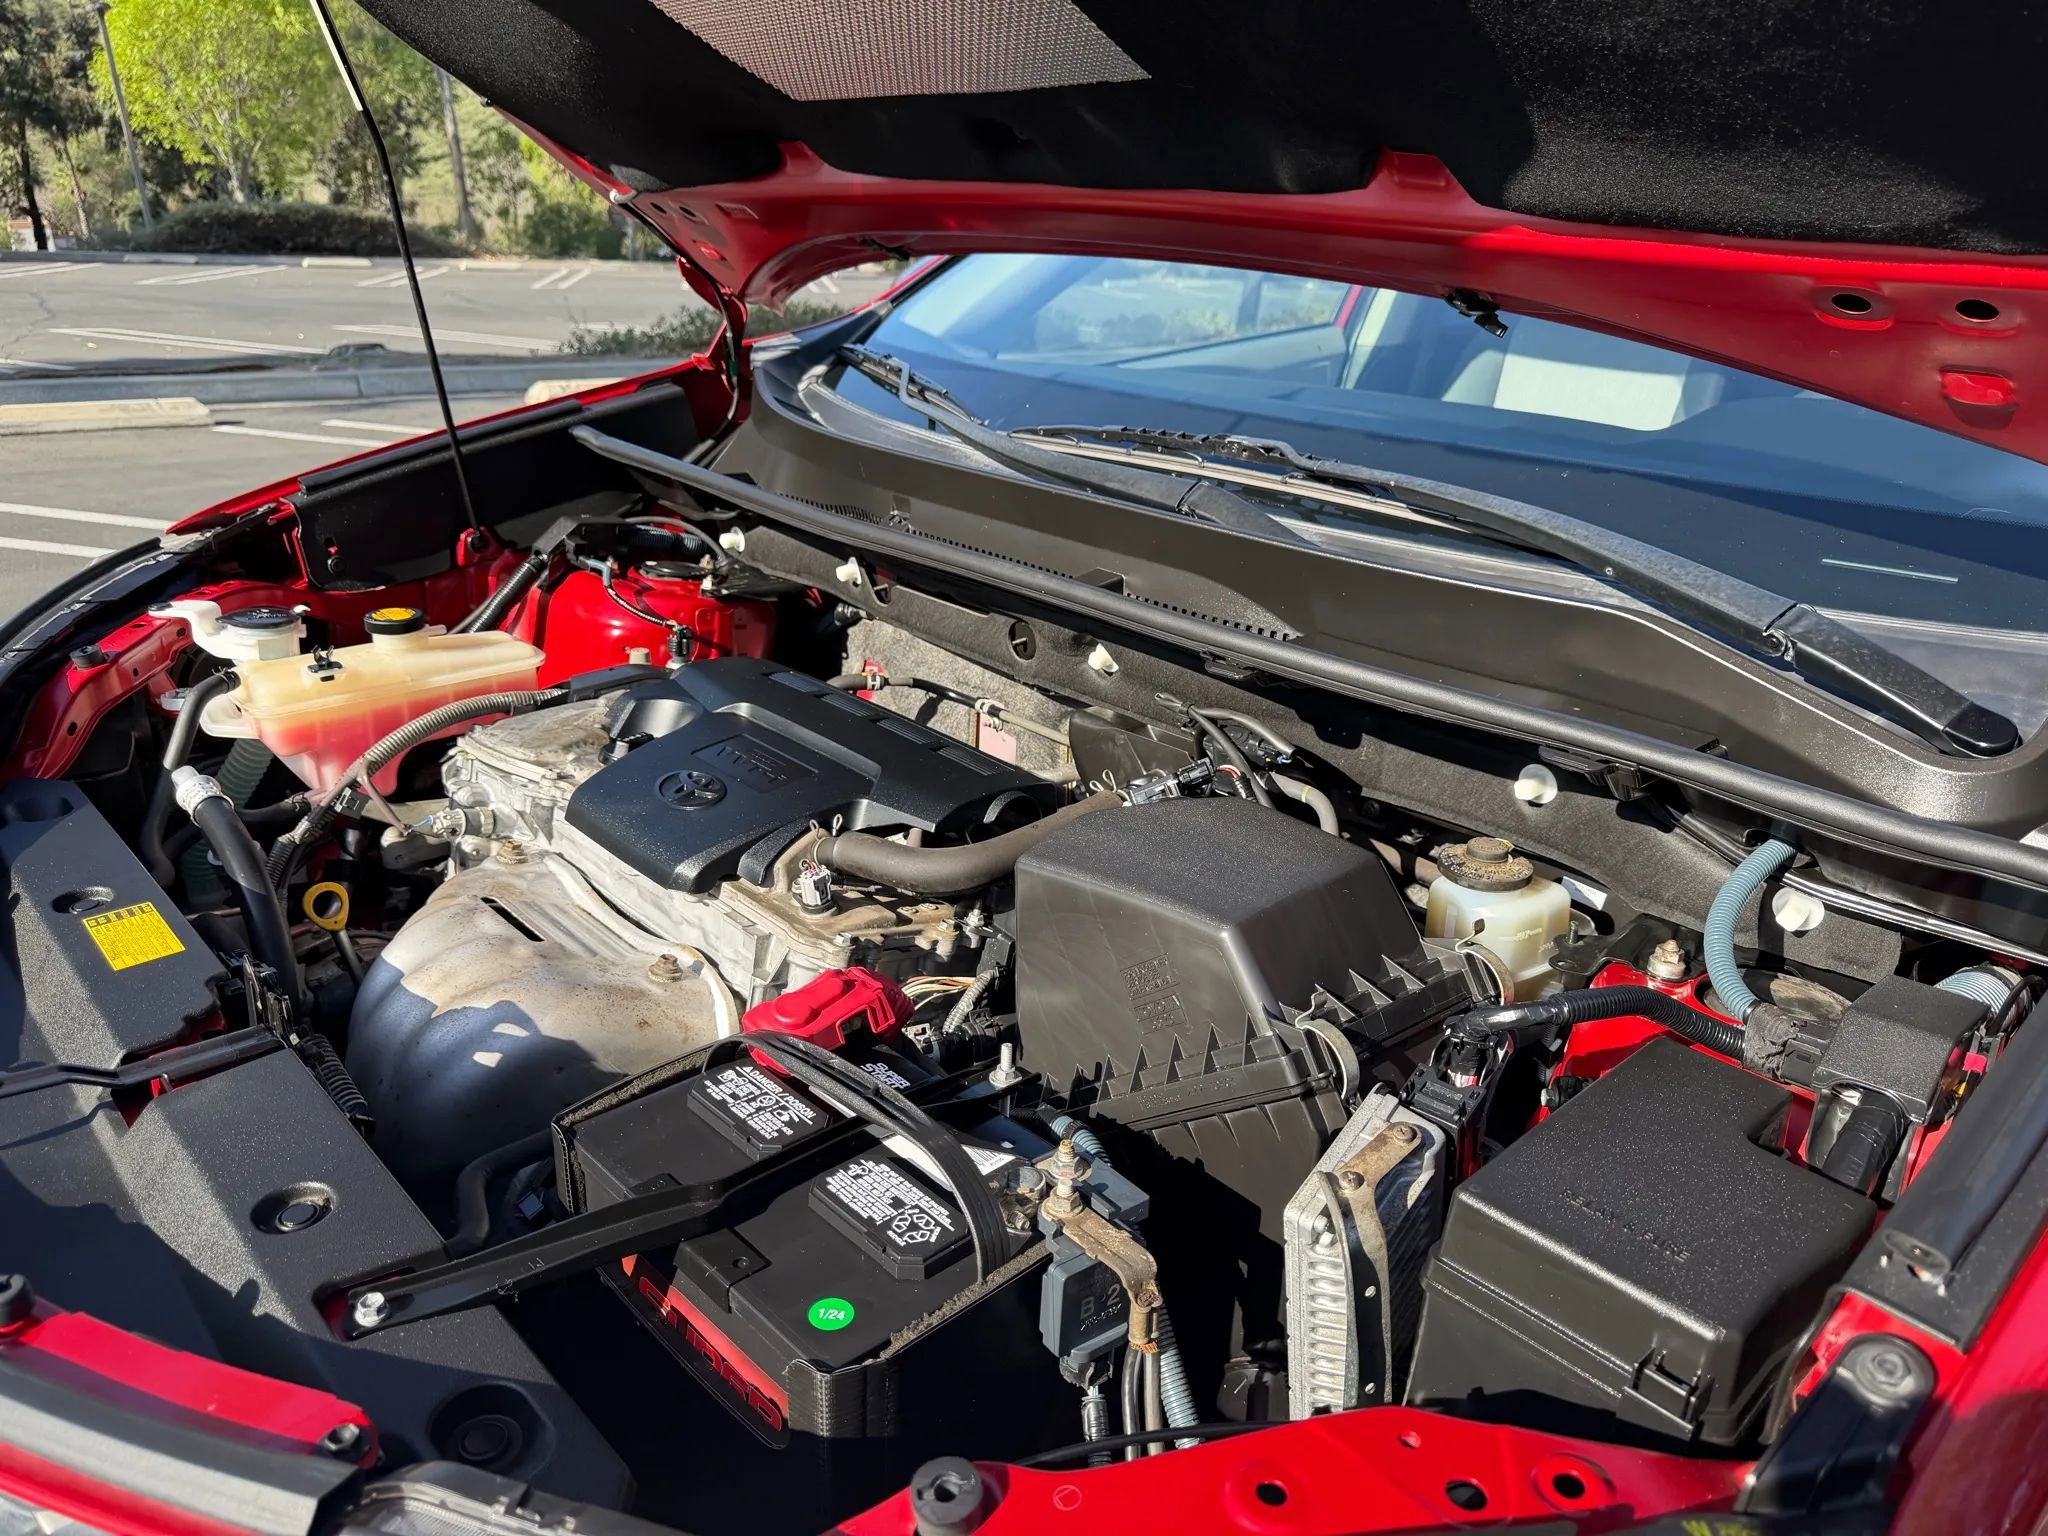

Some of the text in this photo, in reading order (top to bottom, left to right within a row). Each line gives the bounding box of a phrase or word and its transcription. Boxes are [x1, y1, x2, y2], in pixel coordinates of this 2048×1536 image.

[860, 1063, 906, 1089] START
[877, 1062, 911, 1087] SUPER
[749, 1069, 783, 1094] DANGER
[783, 1095, 816, 1119] POISON
[817, 1308, 846, 1320] 1/24
